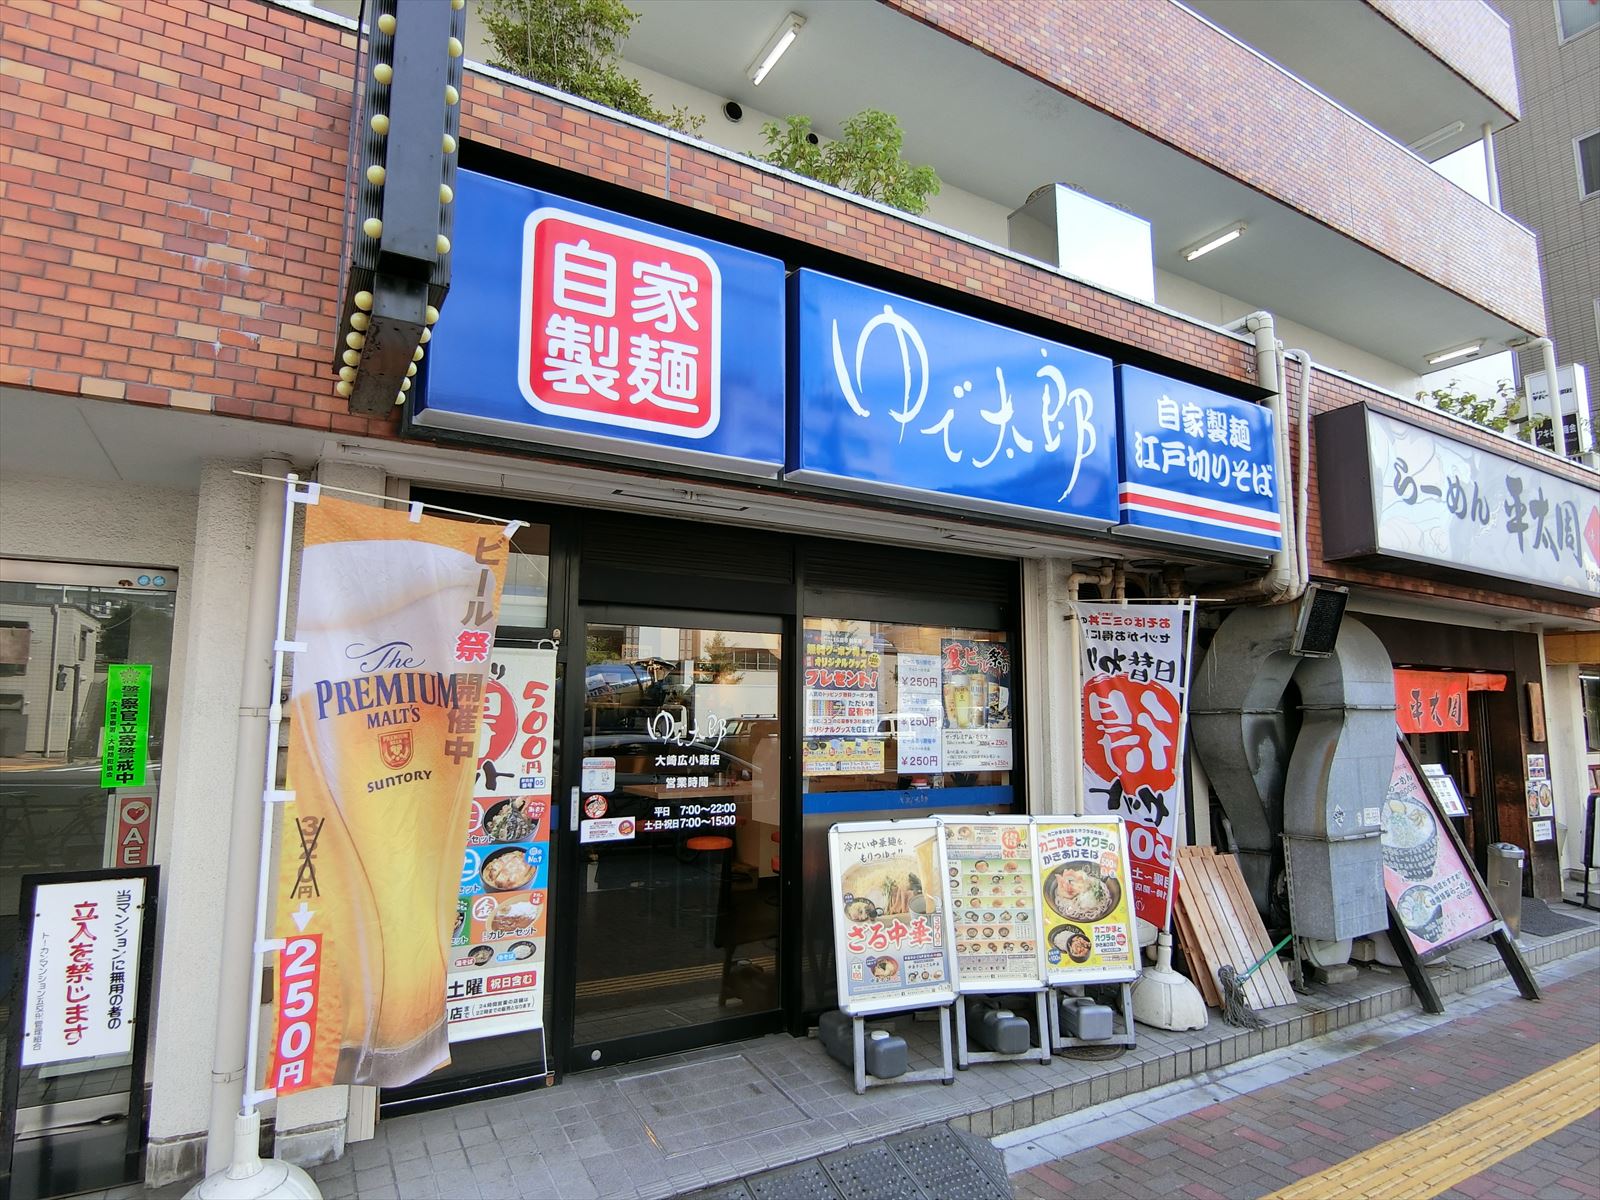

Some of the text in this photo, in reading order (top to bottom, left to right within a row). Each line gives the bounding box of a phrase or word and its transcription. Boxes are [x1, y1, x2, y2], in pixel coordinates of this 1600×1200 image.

[552, 239, 700, 334] 自家
[543, 314, 700, 414] 製麺
[832, 304, 1098, 503] ゆで太郎
[1157, 395, 1252, 451] 自家製麺
[1135, 431, 1274, 498] 江戸切りそば
[1393, 457, 1491, 525] らーめん
[345, 641, 426, 673] The
[444, 535, 507, 765] ビール祭 開催中
[314, 672, 461, 720] PREMIUM
[805, 668, 878, 689] プレゼント!
[116, 685, 140, 784] 警察官立寄警戒中
[367, 706, 421, 730] MALT'S
[521, 680, 549, 774] 500円
[367, 769, 433, 793] SUNTORY
[655, 754, 720, 766] 大崎広小路店
[666, 776, 709, 788] 営業時間
[654, 803, 736, 817] 平日 7:00〜22:00
[680, 816, 736, 828] 7:00〜15:00
[1039, 835, 1115, 853] カニかまとオクラの
[1043, 848, 1098, 865] かきあげそば
[489, 927, 537, 941] カレーセット
[848, 916, 933, 953] ざる中華
[63, 901, 99, 1045] 立入を禁じます
[107, 889, 131, 1029] 当マンションに無用の者の
[448, 973, 533, 999] 土曜 祝日含む
[278, 938, 317, 1088] 250円
